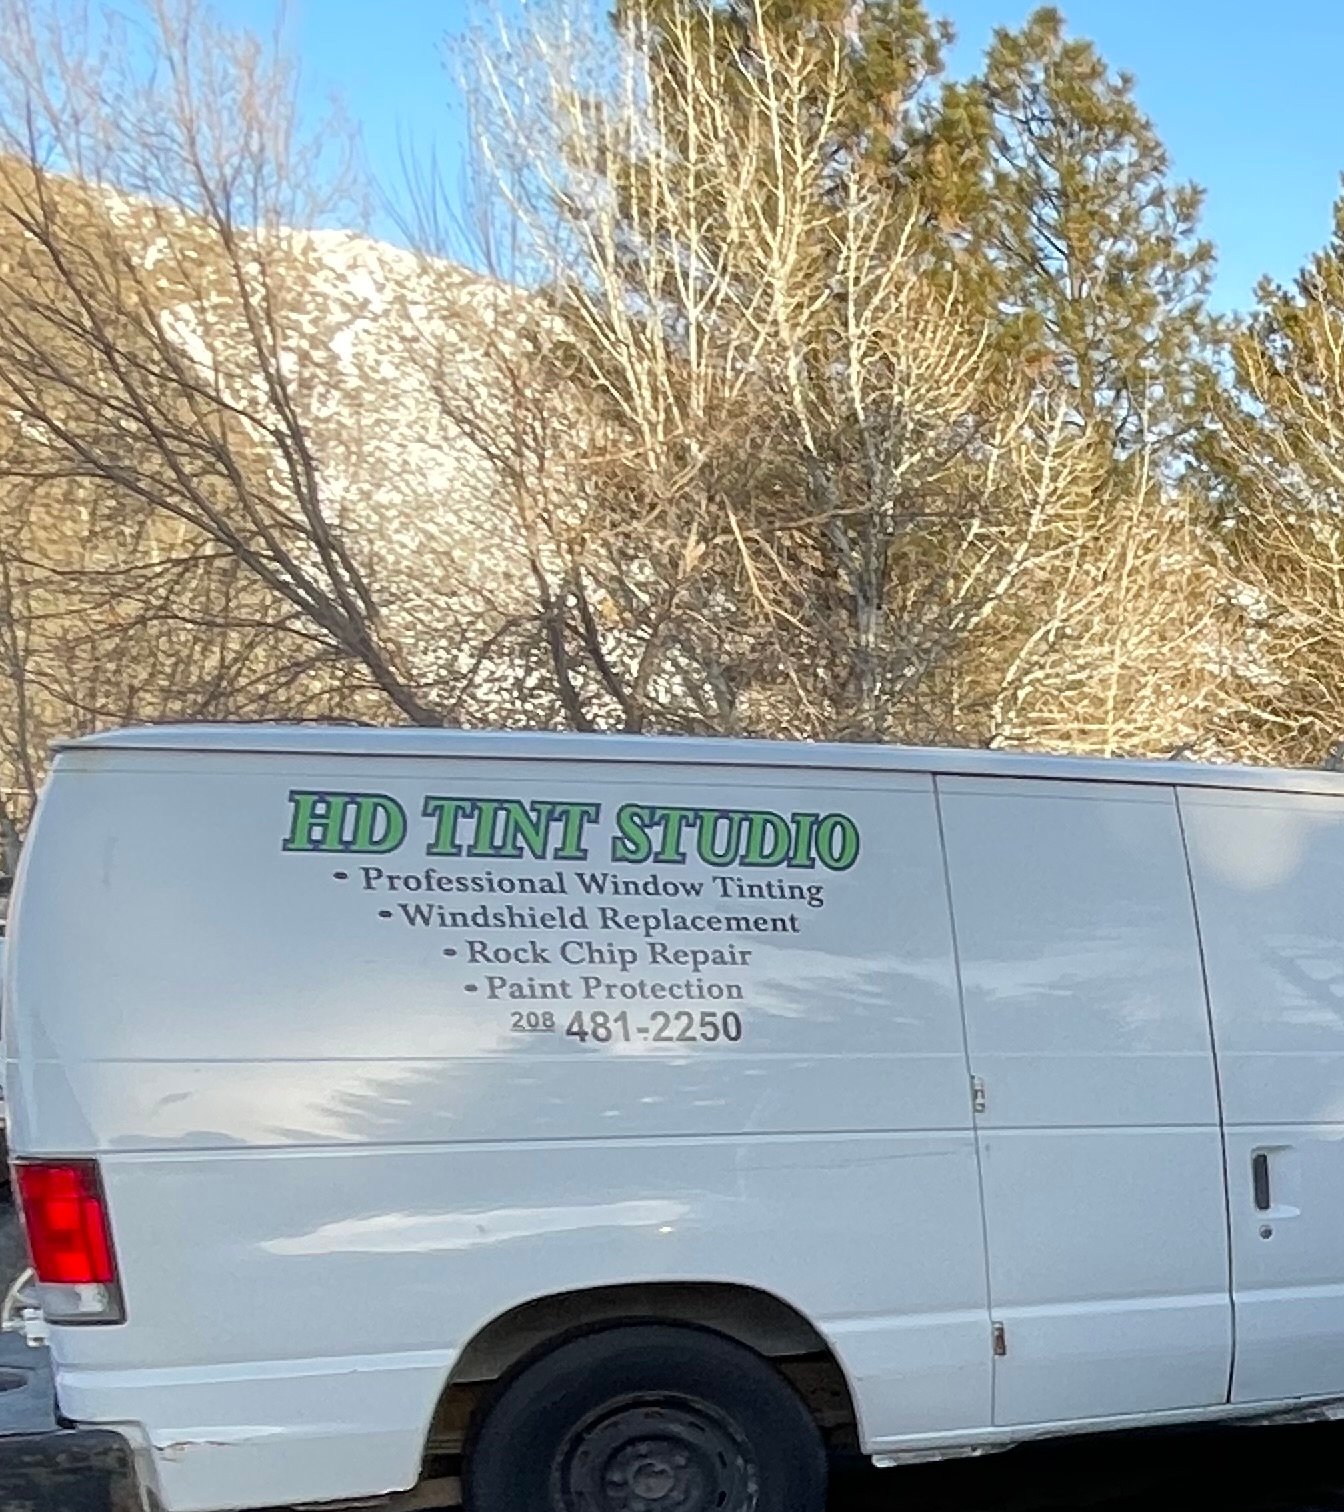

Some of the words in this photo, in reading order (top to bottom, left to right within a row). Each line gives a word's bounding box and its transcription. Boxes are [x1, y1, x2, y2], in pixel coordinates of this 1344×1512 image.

[282, 790, 407, 854] HD
[421, 795, 601, 861] TINT
[611, 803, 859, 872] STUDIO
[360, 866, 567, 894] Professional
[575, 872, 703, 897] Window
[712, 876, 824, 907] Tinting
[397, 903, 588, 930] Windshield
[597, 907, 801, 938] Replacement
[465, 940, 551, 965] Rock
[559, 941, 638, 971] Chip
[646, 942, 752, 972] Repair
[484, 976, 572, 1000] Paint
[580, 976, 744, 1000] Protection
[511, 1011, 556, 1032] 208
[566, 1010, 742, 1042] 481-2250
